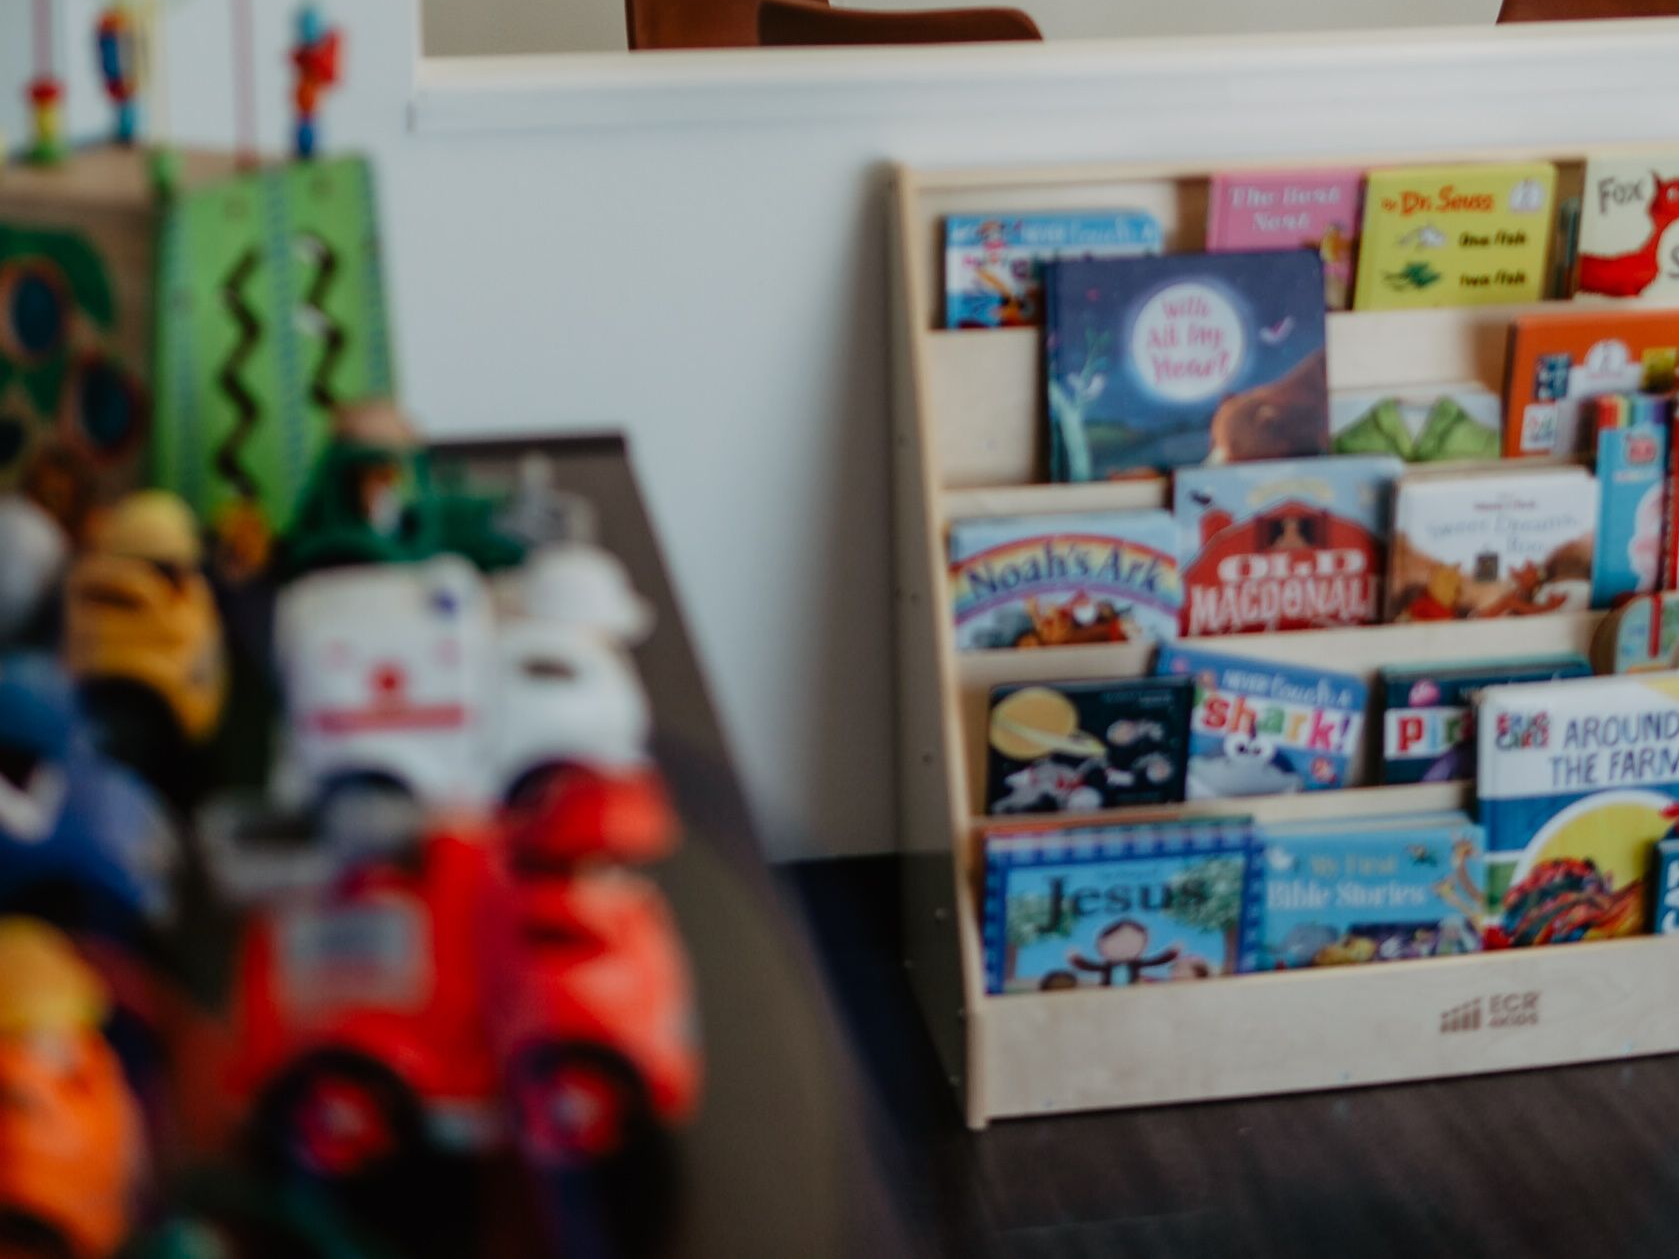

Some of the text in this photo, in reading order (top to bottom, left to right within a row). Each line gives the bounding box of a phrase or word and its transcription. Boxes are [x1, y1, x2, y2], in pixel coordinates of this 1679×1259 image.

[1230, 187, 1273, 208] The
[1437, 185, 1493, 213] Seuss
[1598, 177, 1644, 214] Fox
[969, 542, 1160, 596] Noah's Ark
[1218, 549, 1366, 582] OLD
[1564, 711, 1679, 749] AROUND
[1550, 754, 1599, 786] THE
